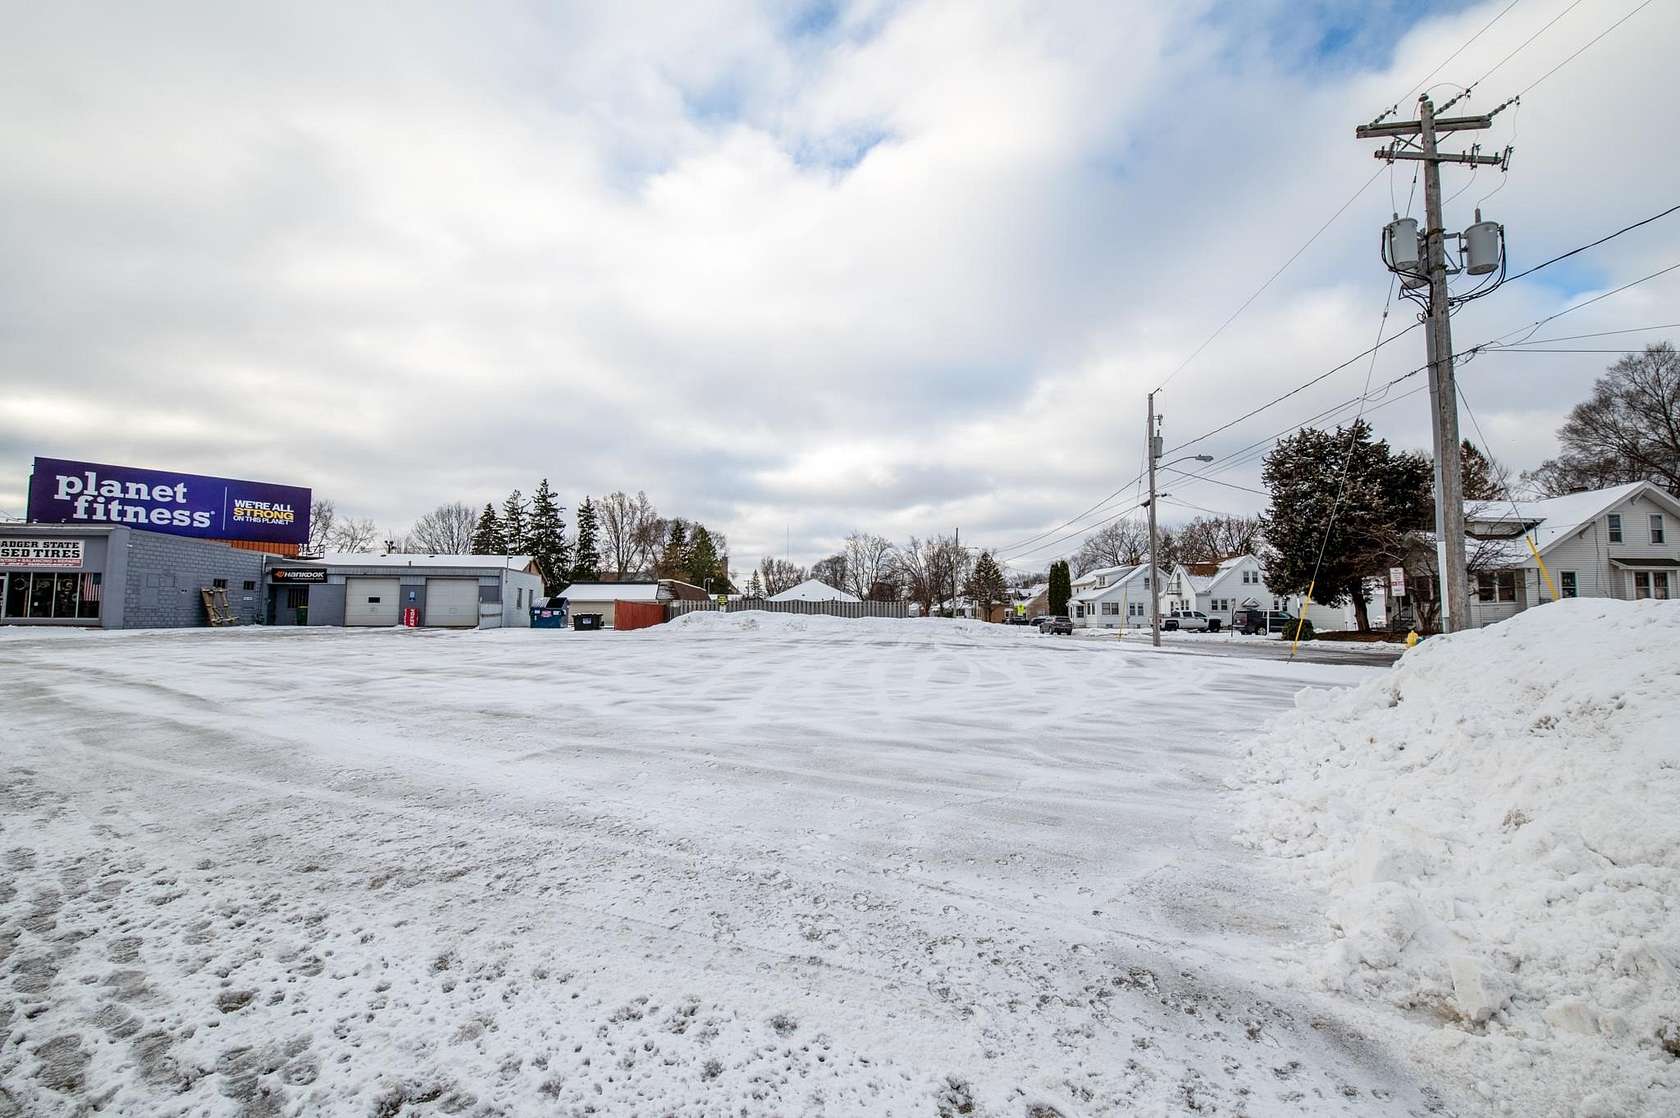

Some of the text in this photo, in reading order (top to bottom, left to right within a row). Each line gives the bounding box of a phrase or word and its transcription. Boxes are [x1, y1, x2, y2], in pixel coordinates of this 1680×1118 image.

[54, 471, 188, 504] planet
[72, 495, 211, 528] fitness
[234, 499, 294, 513] WE'RE ALL
[233, 507, 294, 522] STRONG
[245, 516, 261, 524] THIS
[262, 518, 289, 526] PLANET
[43, 541, 80, 549] STATE
[33, 549, 81, 559] TIRES
